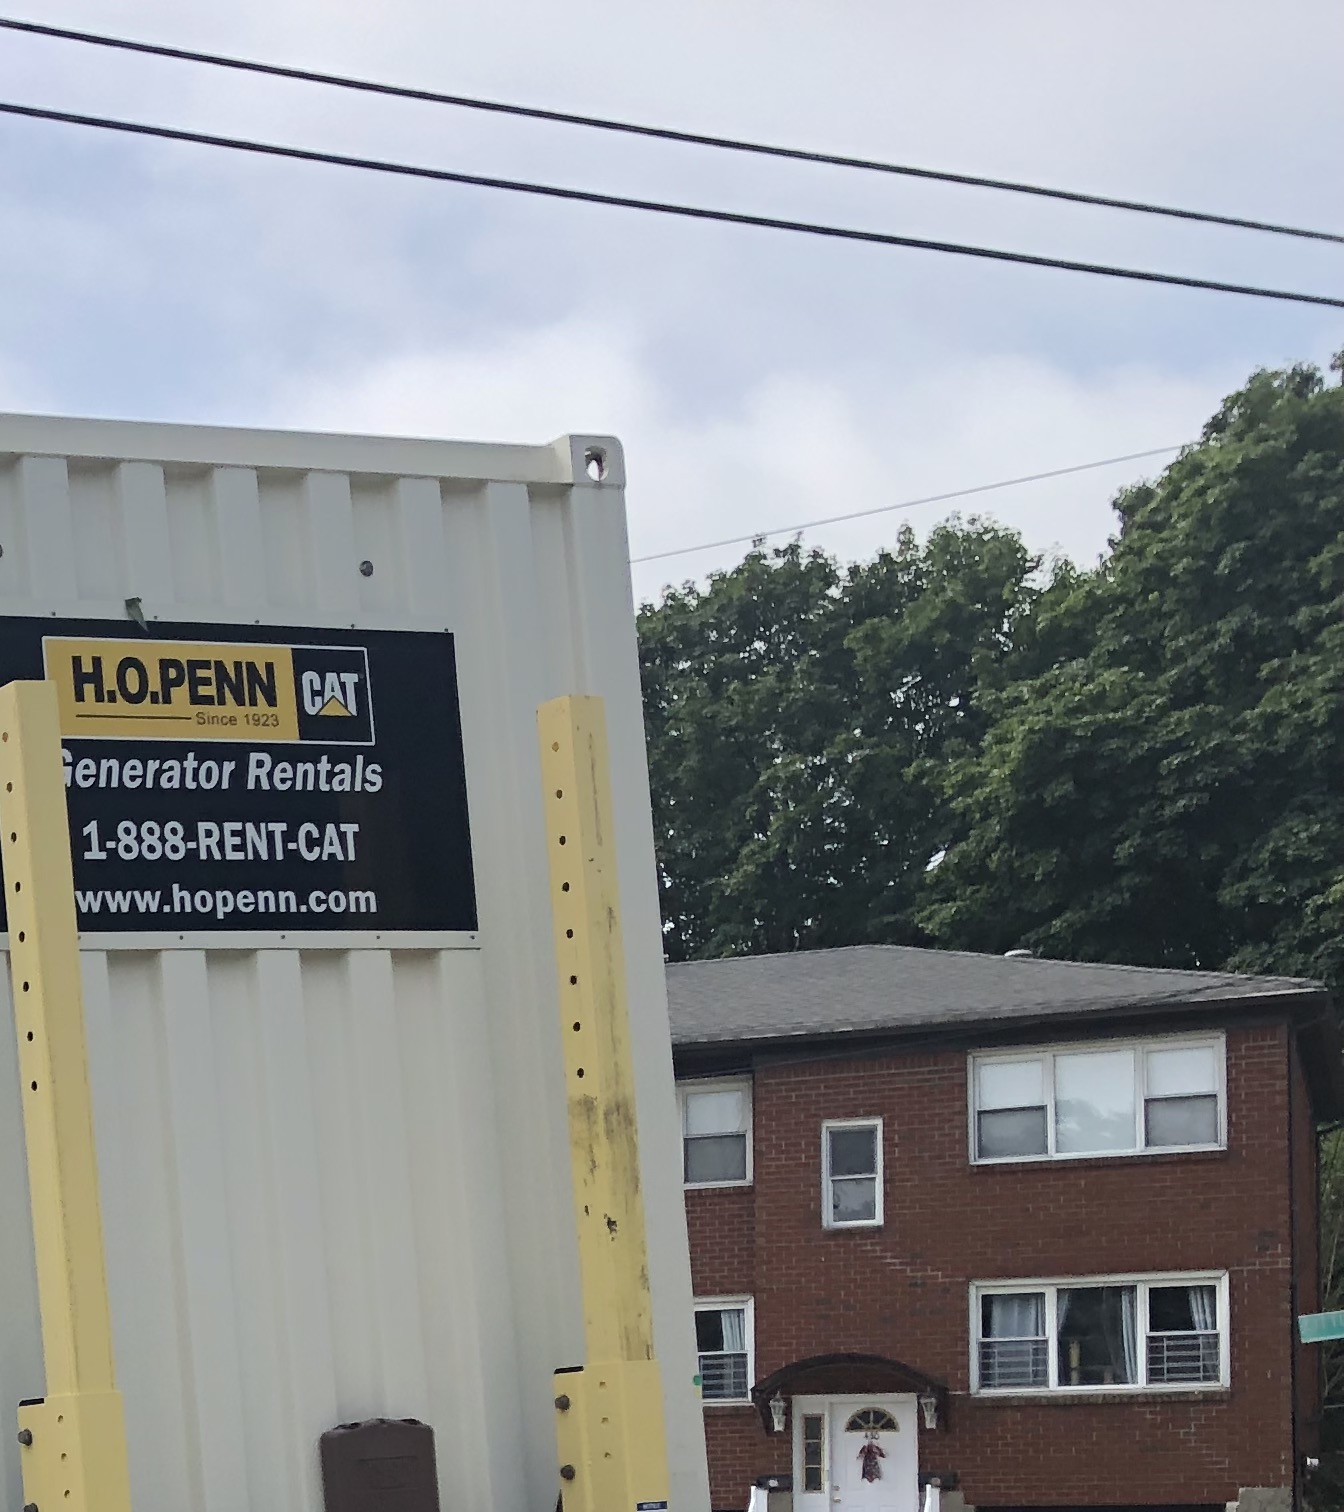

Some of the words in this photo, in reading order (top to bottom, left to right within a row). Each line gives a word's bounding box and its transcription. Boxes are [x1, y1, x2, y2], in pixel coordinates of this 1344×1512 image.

[71, 655, 278, 708] H.O.PENN
[301, 670, 359, 717] CAT
[196, 711, 238, 727] Since
[244, 712, 280, 728] 1923
[246, 752, 383, 793] Rentals
[82, 819, 360, 862] 1-888-RENT-CAT
[74, 883, 378, 919] www.hopenn.com
